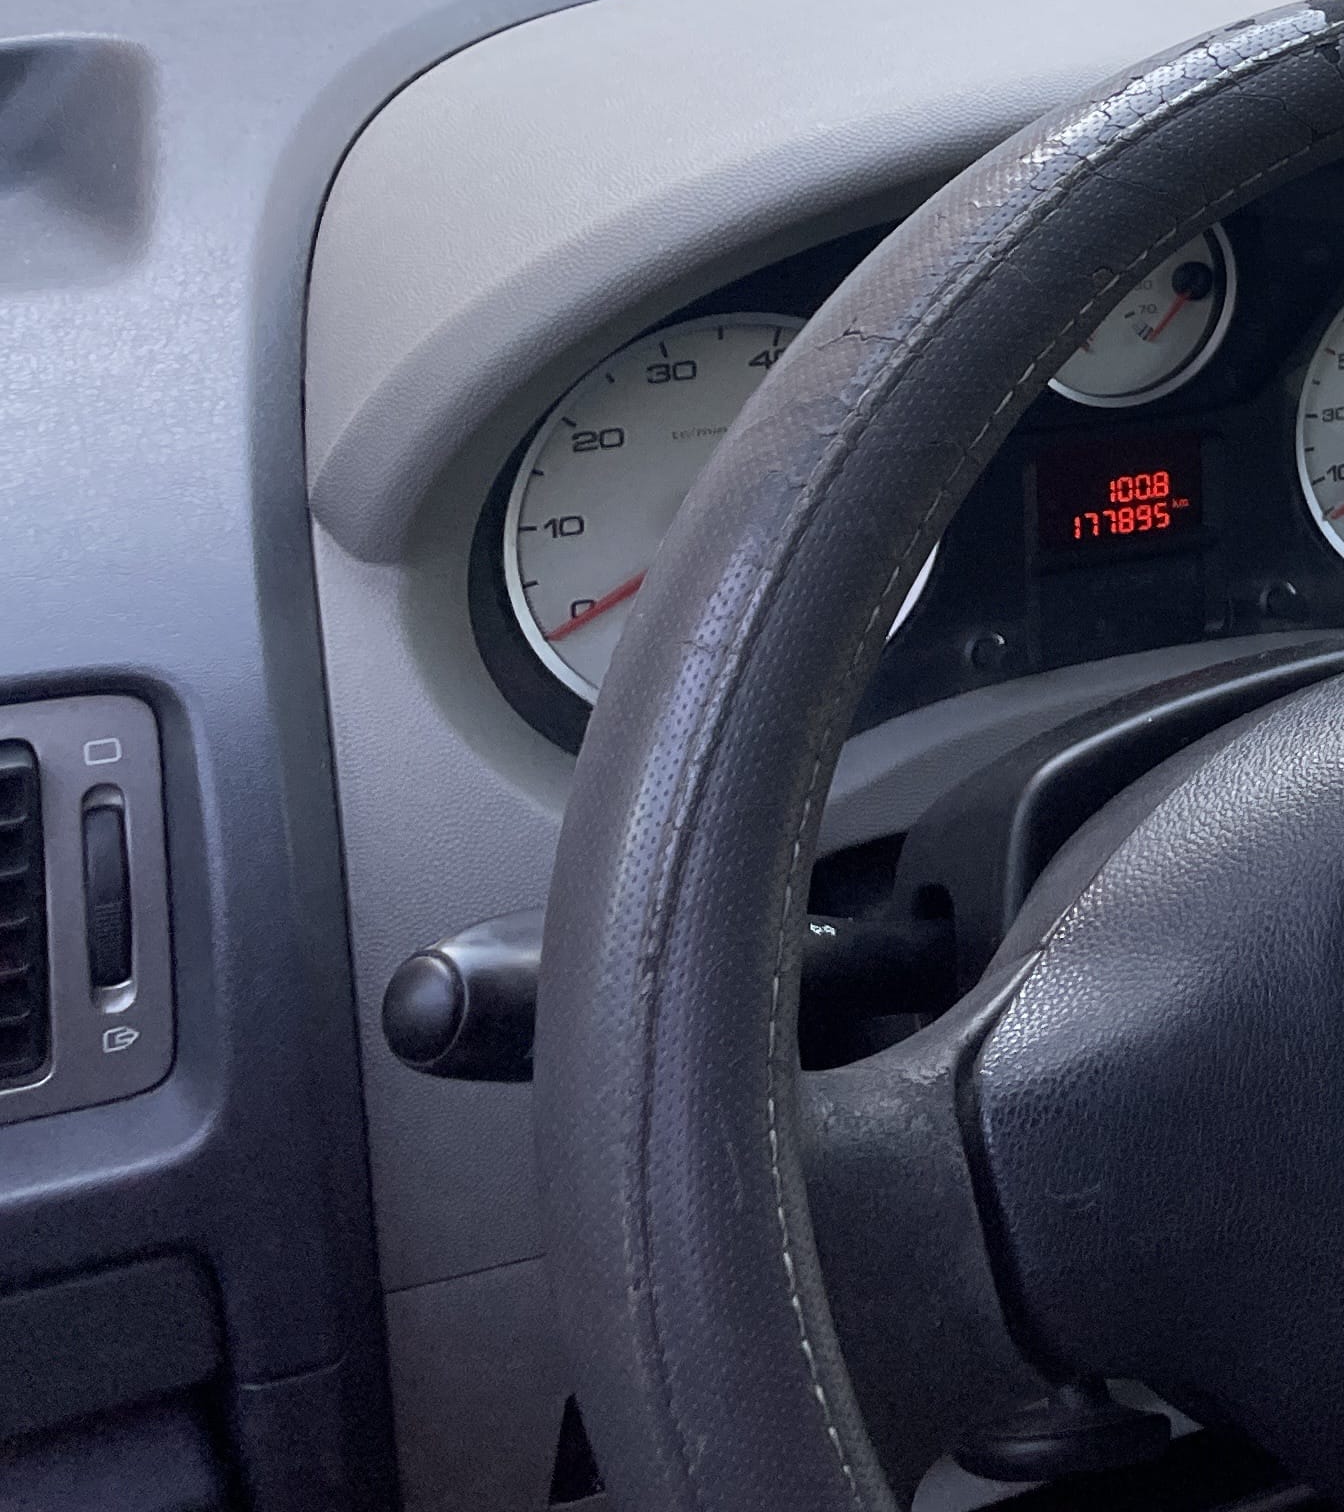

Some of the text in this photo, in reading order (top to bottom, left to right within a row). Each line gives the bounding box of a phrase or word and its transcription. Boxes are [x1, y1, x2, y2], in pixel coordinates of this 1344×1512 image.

[646, 360, 698, 385] 30
[572, 427, 625, 453] 20
[543, 515, 585, 539] 10
[1073, 502, 1171, 540] 177895
